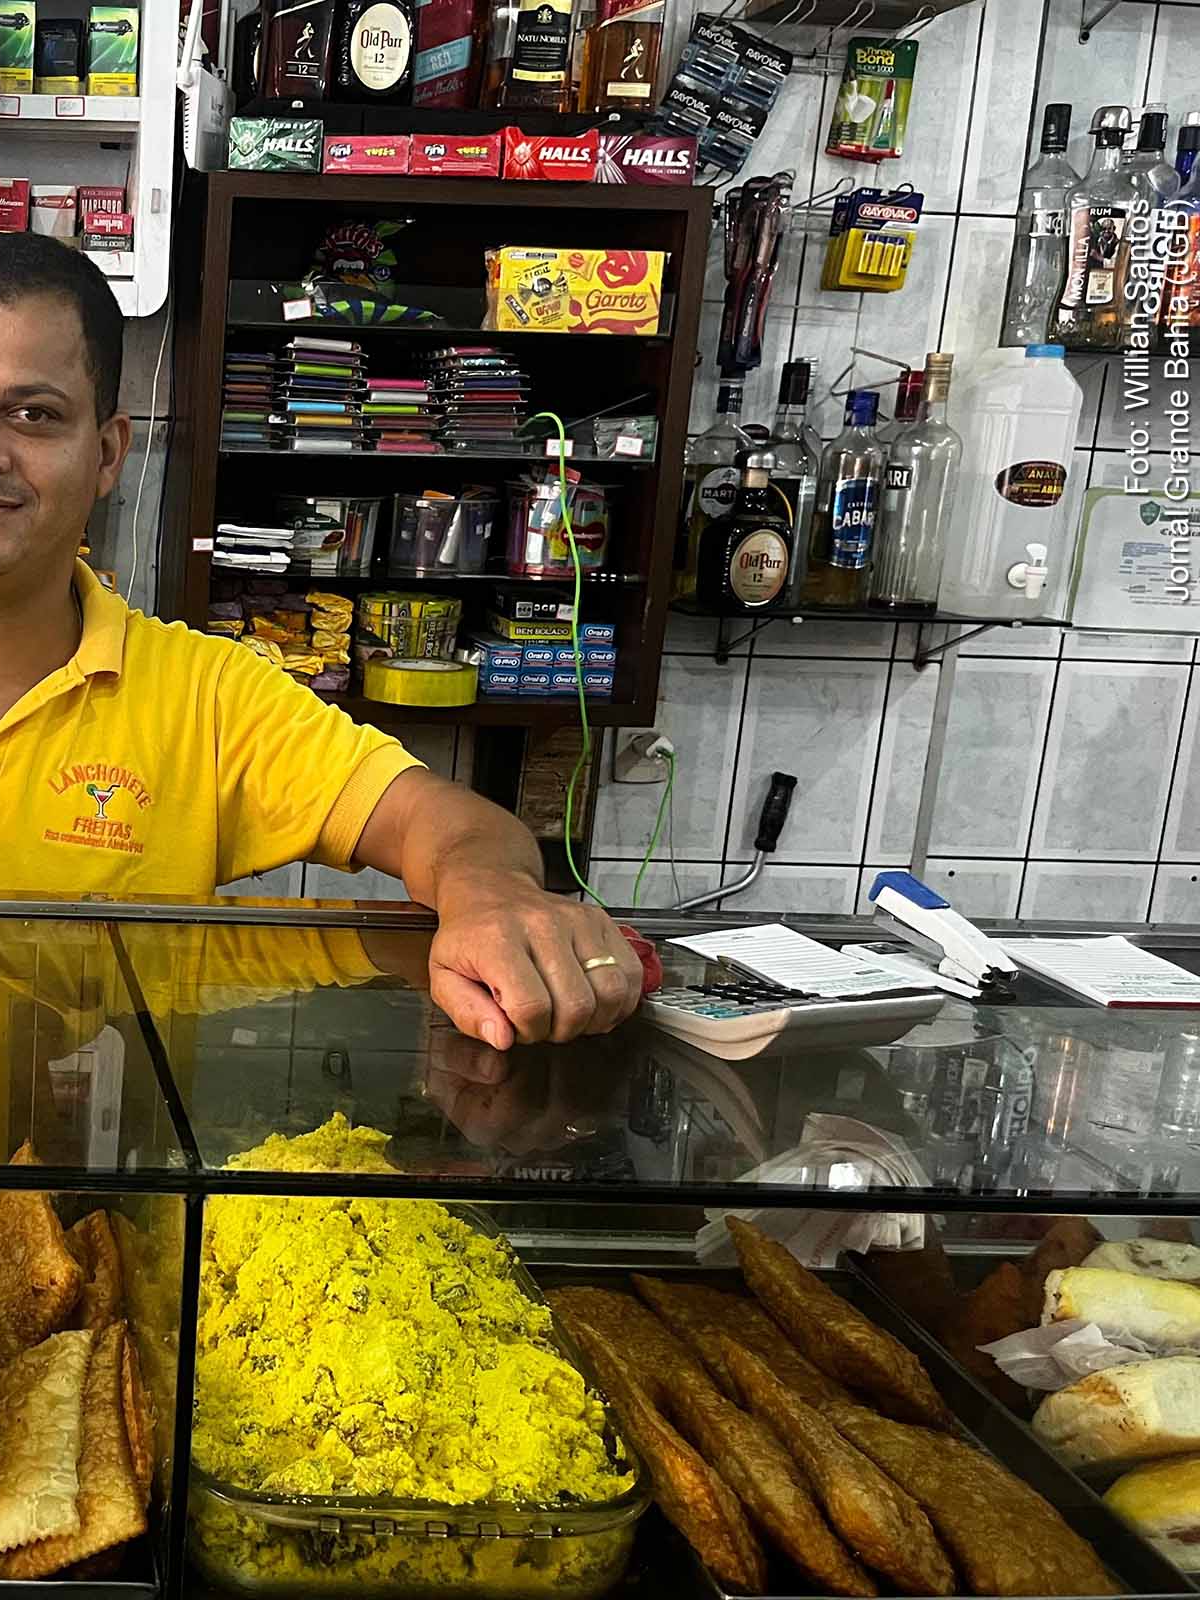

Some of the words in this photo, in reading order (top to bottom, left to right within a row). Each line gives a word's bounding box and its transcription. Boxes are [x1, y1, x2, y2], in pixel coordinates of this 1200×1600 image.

[360, 29, 379, 49] Old
[517, 33, 538, 43] NATU
[697, 26, 739, 50] RAYOVAC
[373, 53, 385, 63] 12
[856, 50, 896, 66] Bond
[865, 47, 893, 56] Three
[746, 48, 787, 72] RAYOVAC
[297, 64, 308, 75] 12
[670, 89, 711, 113] RAYOVAC
[716, 111, 757, 135] RAYOVAC
[263, 137, 315, 153] HALLS
[538, 147, 591, 162] HALLS
[622, 149, 691, 168] HALLS
[861, 206, 914, 220] RAYOVAC
[1089, 208, 1112, 216] RUM
[586, 289, 647, 313] Garoto
[740, 552, 758, 570] Old
[752, 573, 763, 583] 12
[516, 627, 533, 635] BEM
[48, 764, 155, 810] LANCHONETE
[72, 816, 133, 840] FREITAS
